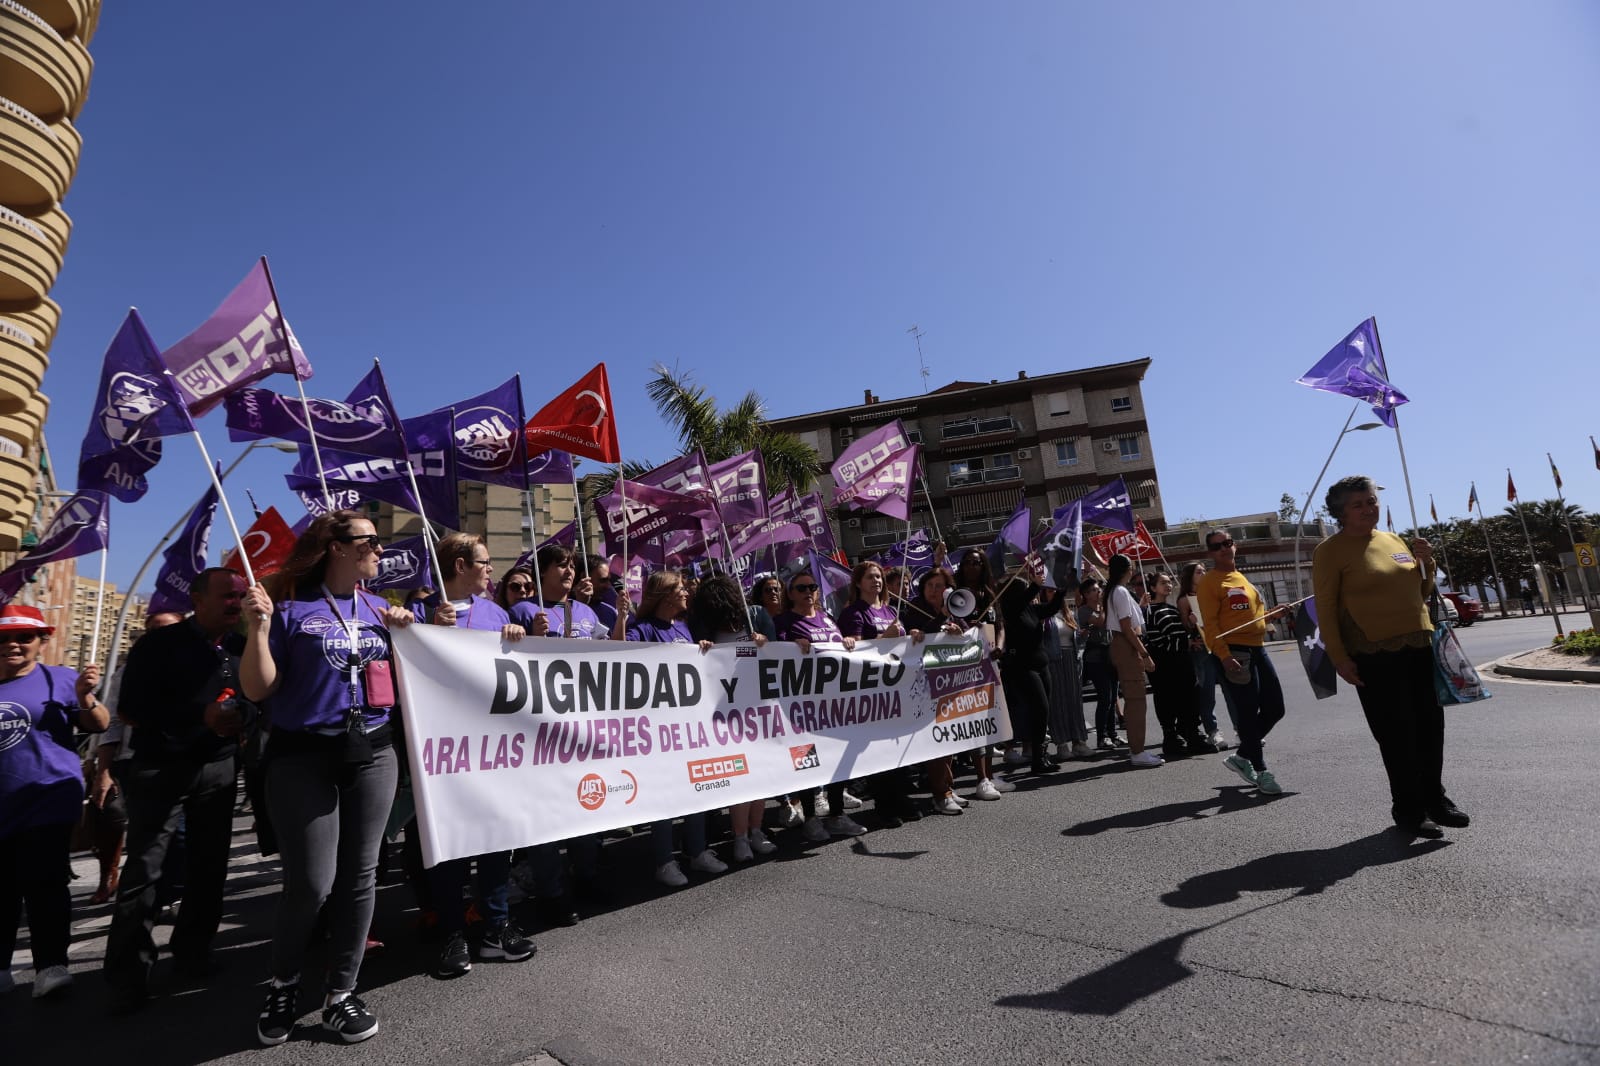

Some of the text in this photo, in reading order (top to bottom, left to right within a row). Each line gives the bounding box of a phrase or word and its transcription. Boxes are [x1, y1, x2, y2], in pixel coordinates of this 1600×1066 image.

[327, 638, 384, 650] FEMISTA
[490, 656, 906, 714] DIGNIDAD Y EMPLEO
[951, 666, 985, 687] MUJERES
[955, 690, 989, 712] EMPLEO
[422, 690, 902, 776] ARA LAS MUJERES DE LA COSTA GRANADINA
[951, 717, 998, 742] SALARIOS
[691, 759, 734, 779] CCOO
[795, 755, 818, 769] CGT
[607, 783, 634, 793] Granada
[694, 779, 731, 792] Granada
